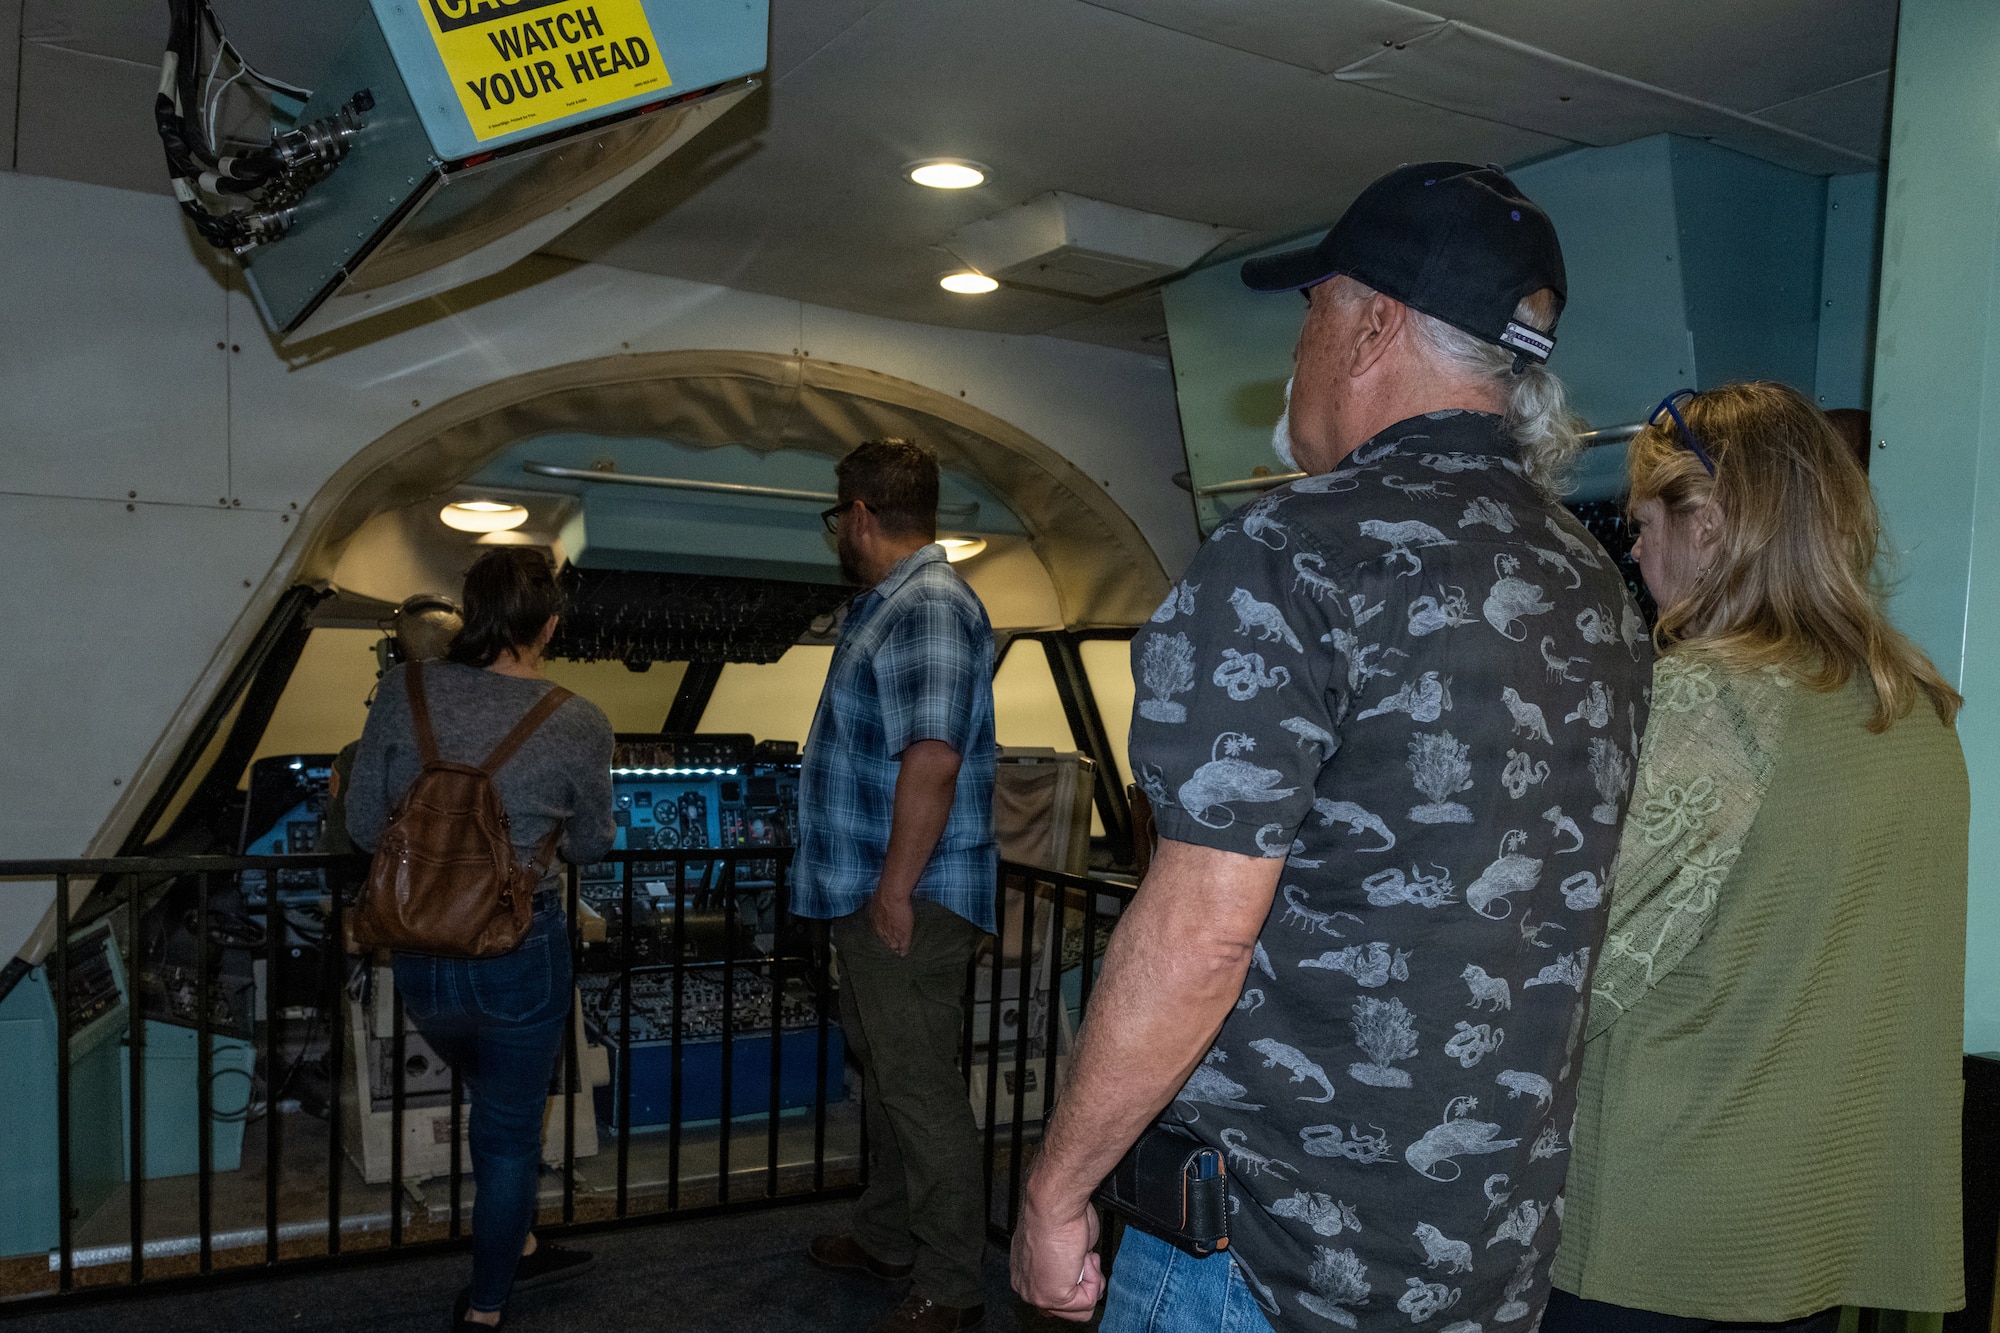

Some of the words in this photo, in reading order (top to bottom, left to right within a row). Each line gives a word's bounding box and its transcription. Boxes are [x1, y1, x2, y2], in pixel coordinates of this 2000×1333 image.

[487, 6, 604, 62] WATCH
[466, 60, 564, 111] YOUR
[565, 36, 650, 84] HEAD
